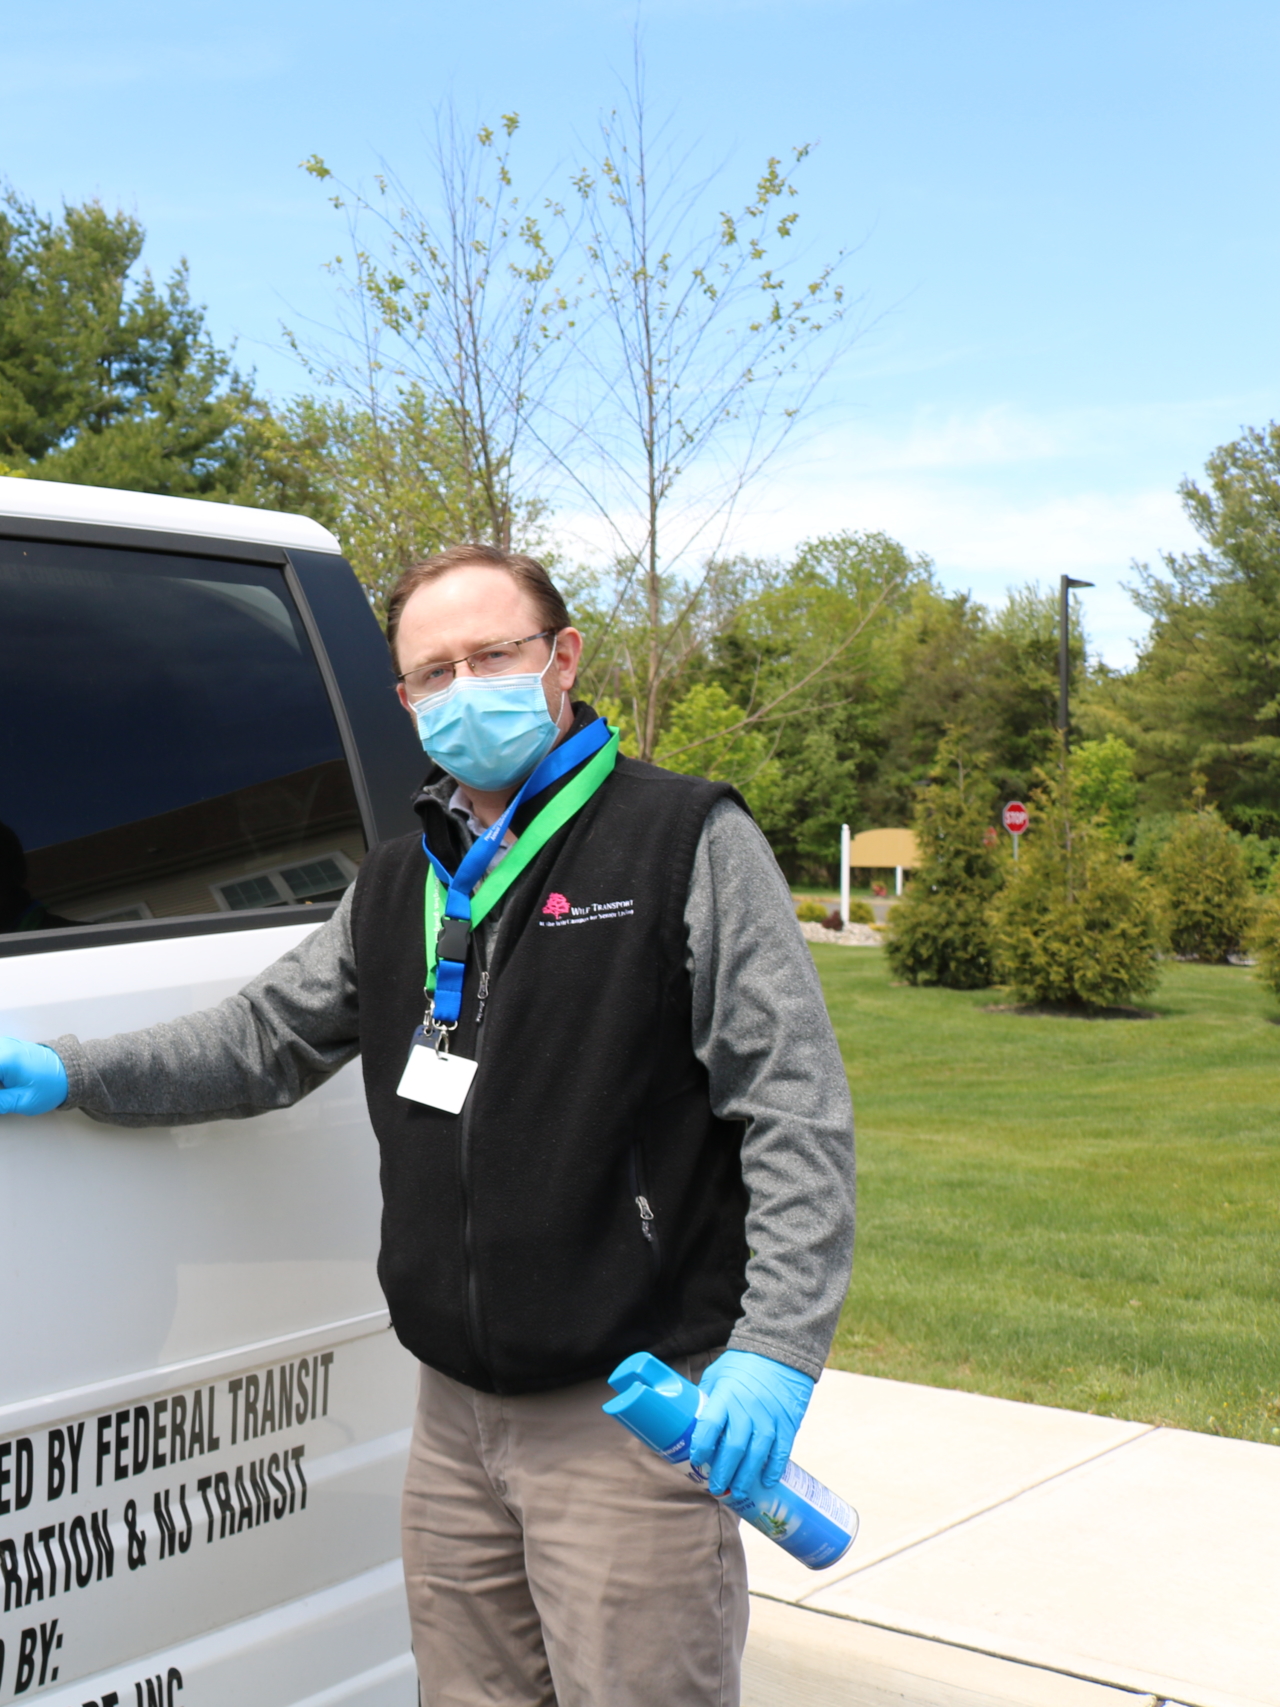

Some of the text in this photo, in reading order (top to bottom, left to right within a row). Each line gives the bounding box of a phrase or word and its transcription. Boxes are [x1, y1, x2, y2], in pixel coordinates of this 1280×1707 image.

[1005, 811, 1027, 825] STOP
[47, 1421, 85, 1502] BY
[96, 1386, 220, 1487] FEDERAL
[228, 1352, 333, 1445] TRANSIT
[124, 1499, 147, 1571] &
[154, 1484, 193, 1560] NJ
[197, 1445, 308, 1543] TRANSIT
[14, 1619, 63, 1697] BY:
